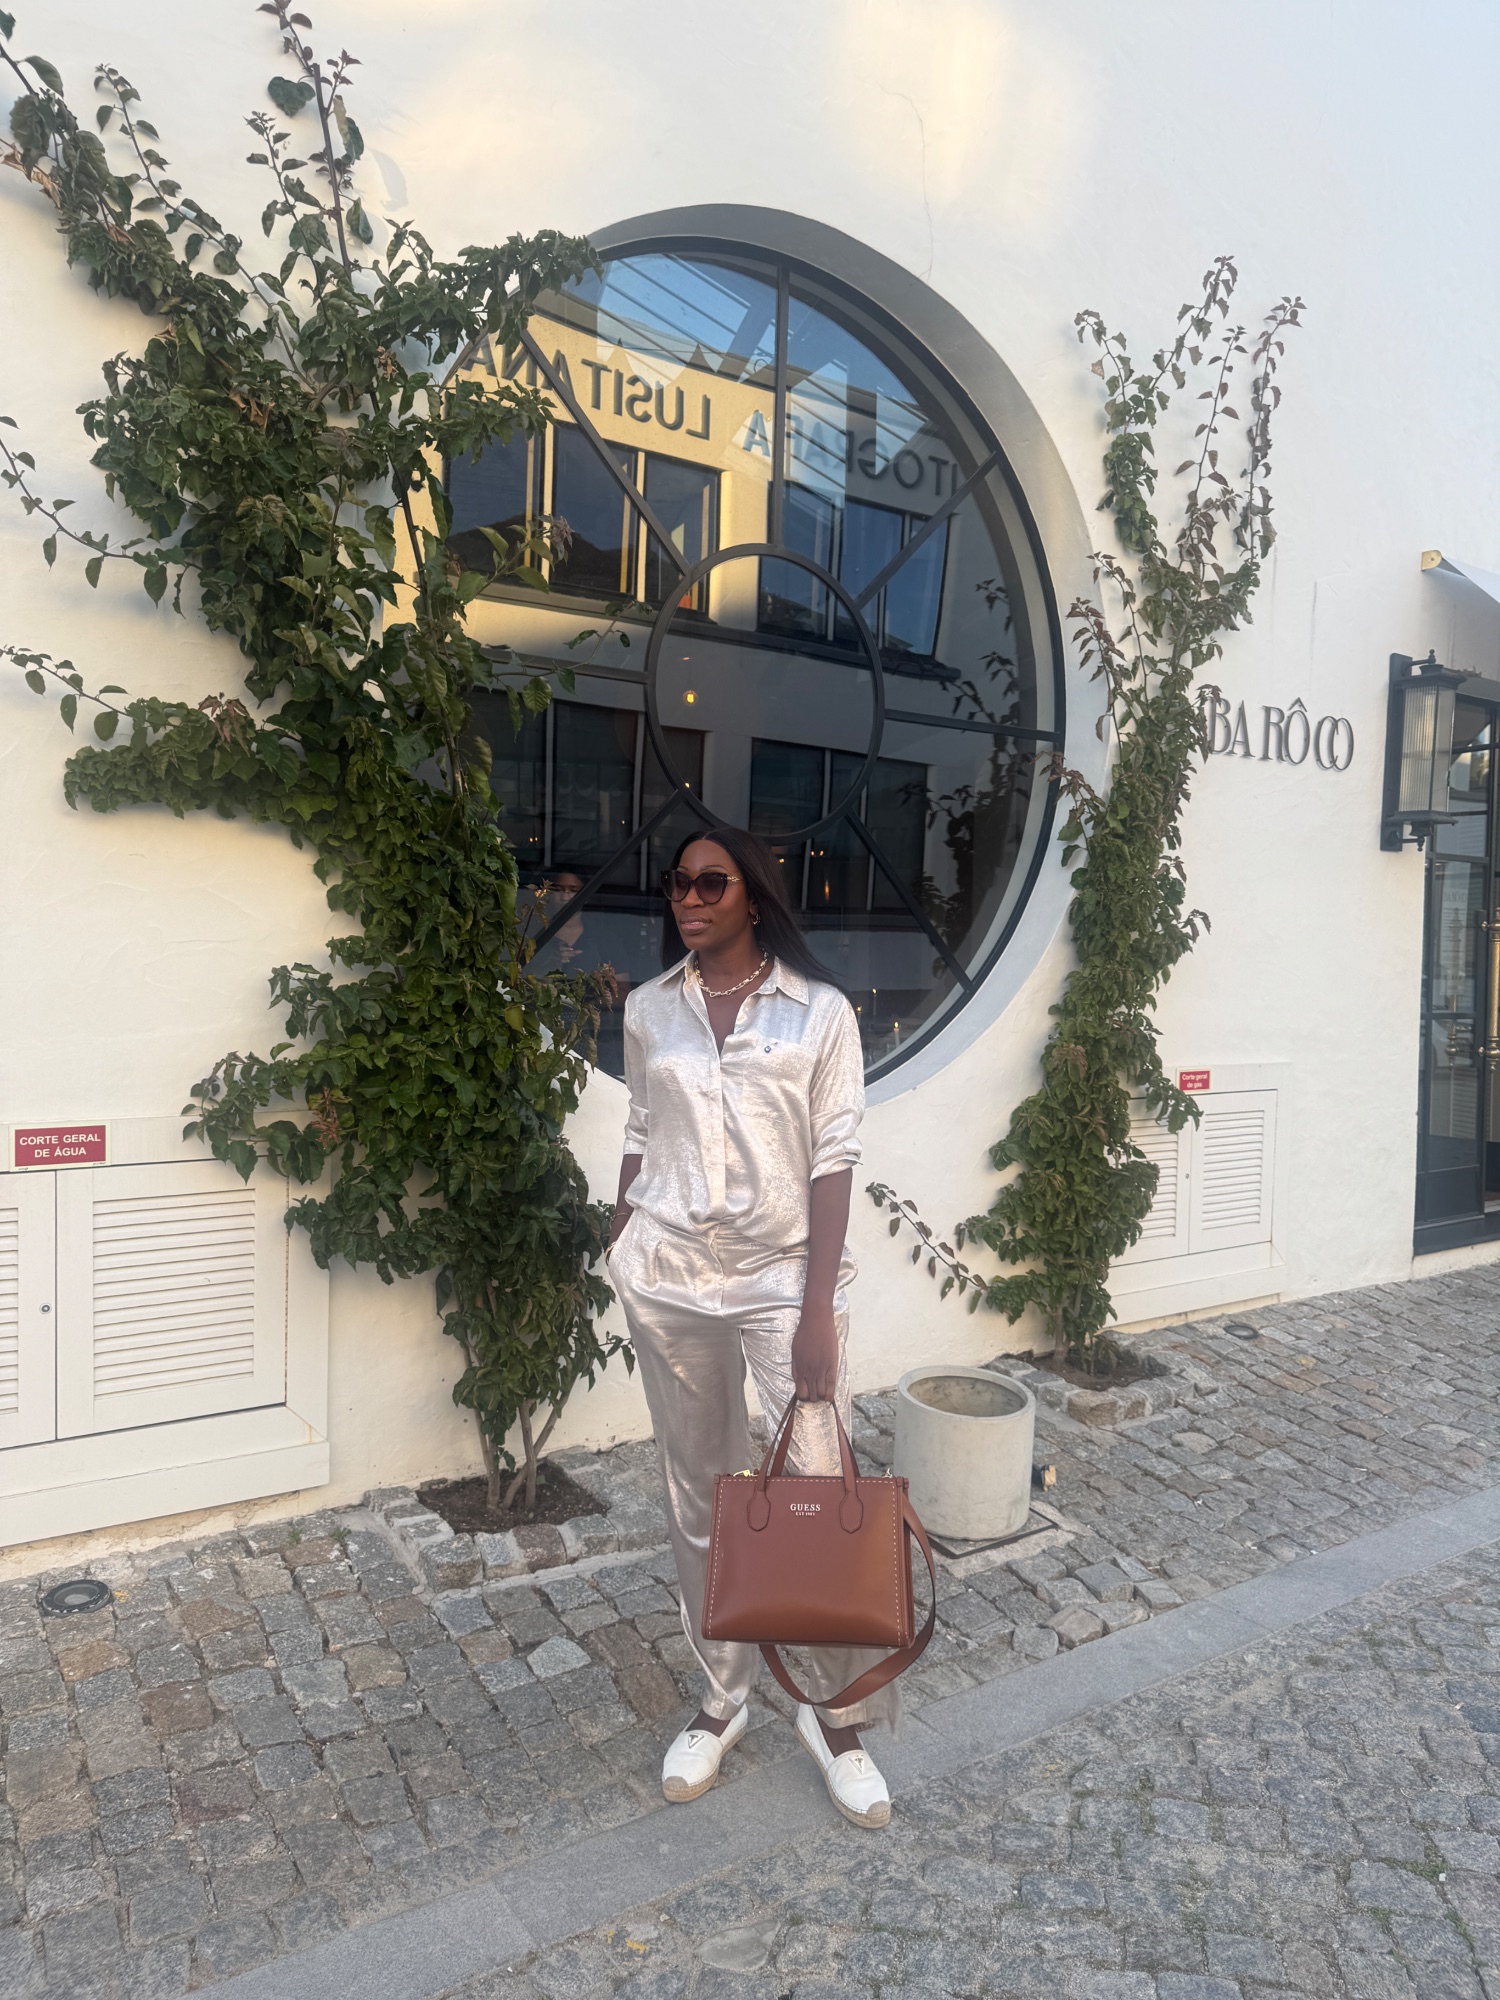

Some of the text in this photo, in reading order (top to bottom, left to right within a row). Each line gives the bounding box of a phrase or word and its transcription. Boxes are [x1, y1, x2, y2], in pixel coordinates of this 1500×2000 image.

[1195, 1073, 1207, 1081] geral
[19, 1133, 101, 1146] CORTE GERAL
[34, 1146, 87, 1158] DE ÁGUA
[790, 1503, 821, 1511] GUESS
